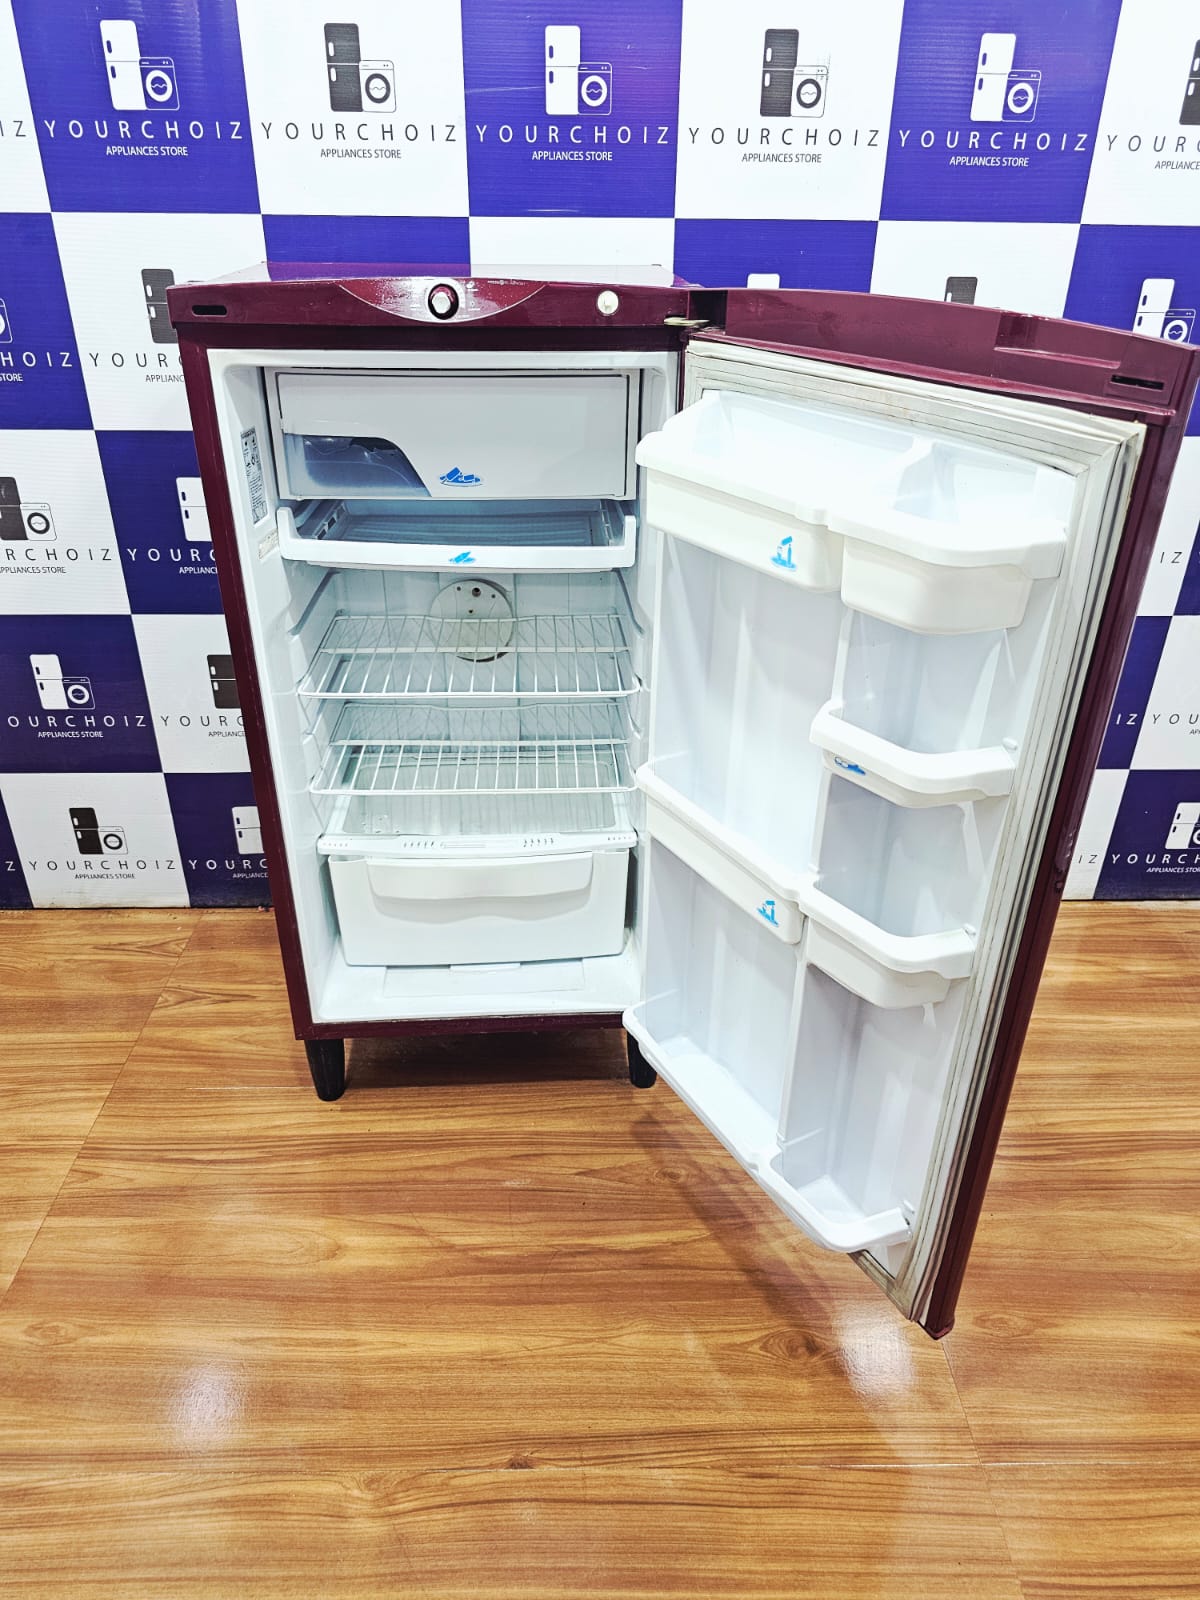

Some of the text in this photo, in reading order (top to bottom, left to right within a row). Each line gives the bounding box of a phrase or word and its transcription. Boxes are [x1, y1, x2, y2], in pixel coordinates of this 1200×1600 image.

[44, 119, 243, 140] YOURCHOIZ
[261, 122, 457, 142] YOURCHOIZ
[475, 124, 669, 144] YOURCHOIZ
[688, 127, 879, 147] YOURCHOIZ
[899, 129, 1088, 151] YOURCHOIZ
[105, 145, 188, 156] APPLIANCES STORE
[320, 148, 402, 159] APPLIANCES STORE
[531, 150, 613, 161] APPLIANCES STORE
[741, 152, 823, 164] APPLIANCES STORE
[949, 155, 1030, 167] APPLIANCES STORE
[89, 353, 182, 368] YOUR
[5, 548, 111, 561] RCHOIZ
[0, 566, 67, 574] PPLIANCES STORE
[7, 715, 147, 728] OURCHOIZ
[37, 731, 104, 739] APPLIANCES STORE
[28, 859, 176, 871] YOURCHOIZ
